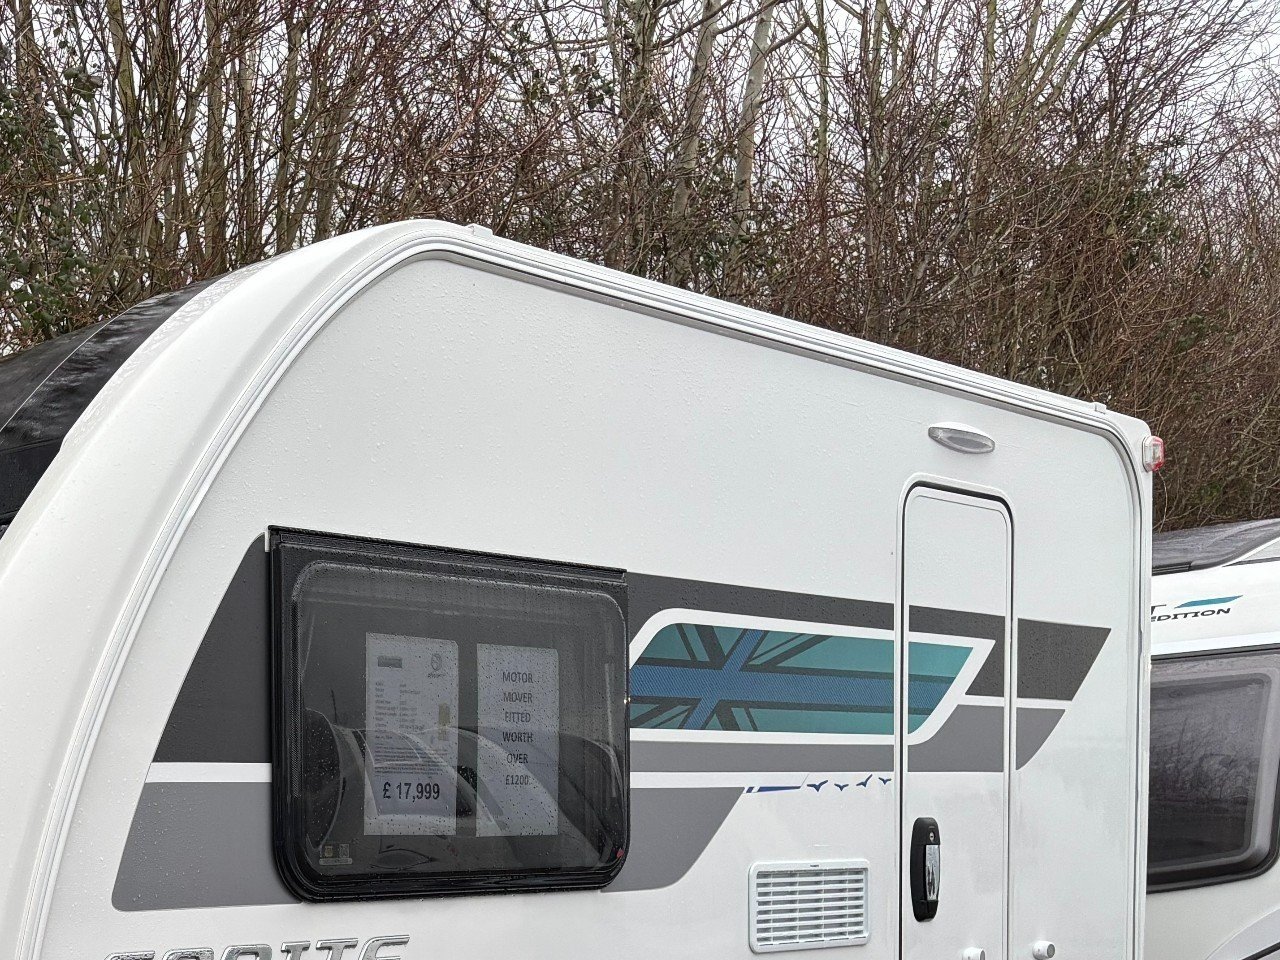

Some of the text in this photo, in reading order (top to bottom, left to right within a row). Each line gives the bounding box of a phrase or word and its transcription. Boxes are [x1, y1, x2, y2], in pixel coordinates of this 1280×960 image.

[502, 671, 533, 683] MOTOR
[503, 691, 533, 703] MOVER
[505, 711, 531, 723] FITTED
[502, 731, 533, 742] WORTH
[506, 753, 528, 764] OVER
[382, 781, 440, 802] £ 17,999
